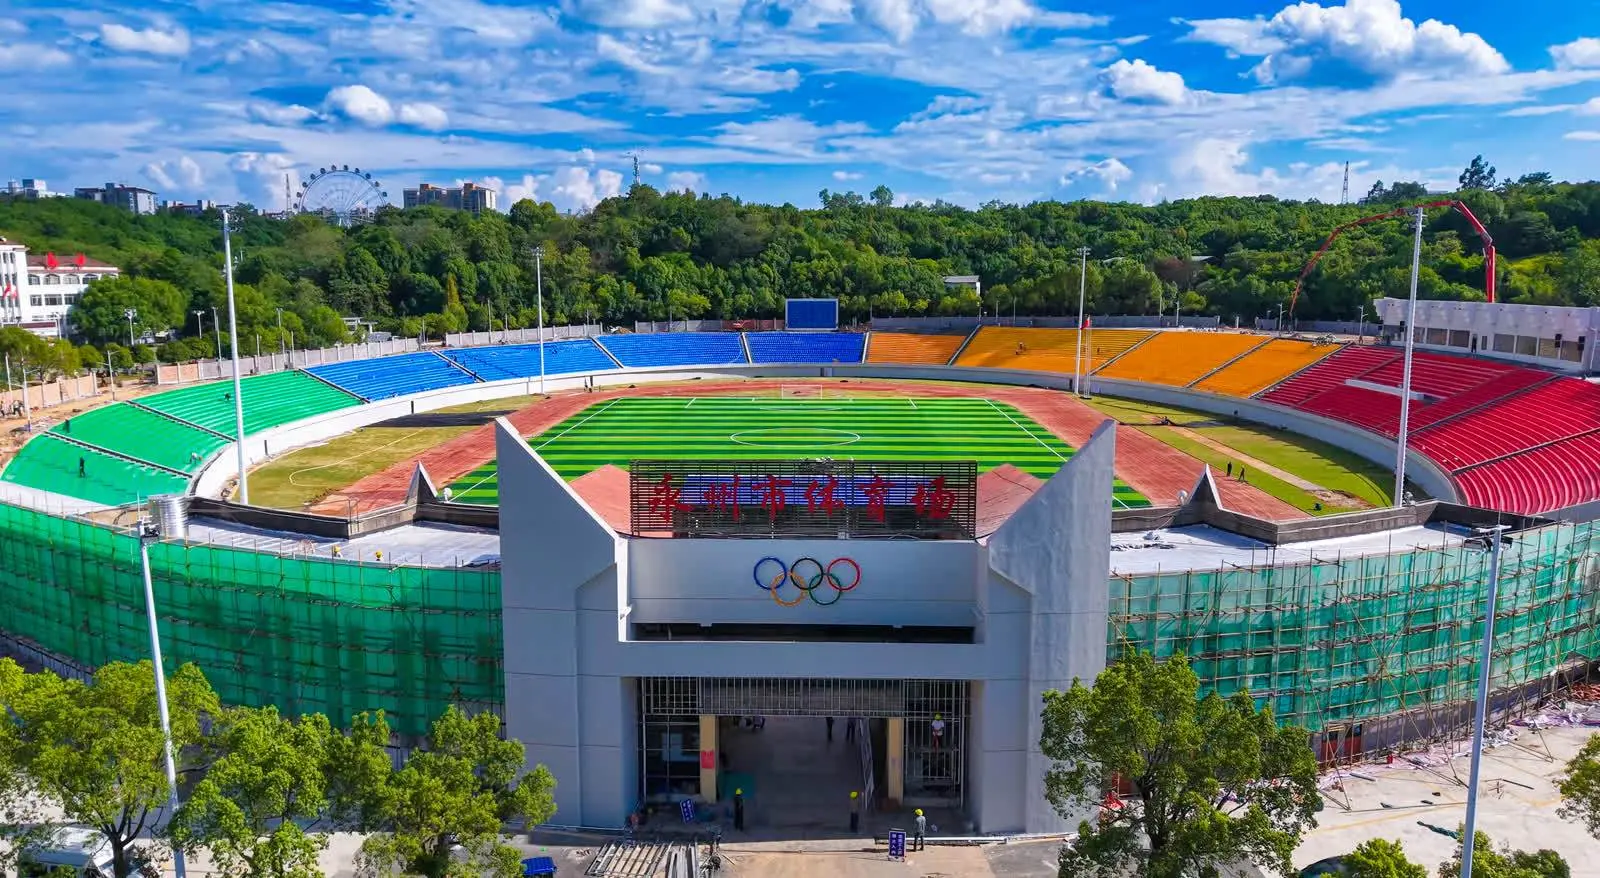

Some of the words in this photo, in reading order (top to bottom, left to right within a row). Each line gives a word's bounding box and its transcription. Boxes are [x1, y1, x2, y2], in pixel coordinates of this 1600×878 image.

[648, 473, 956, 522] 永州市体育场
